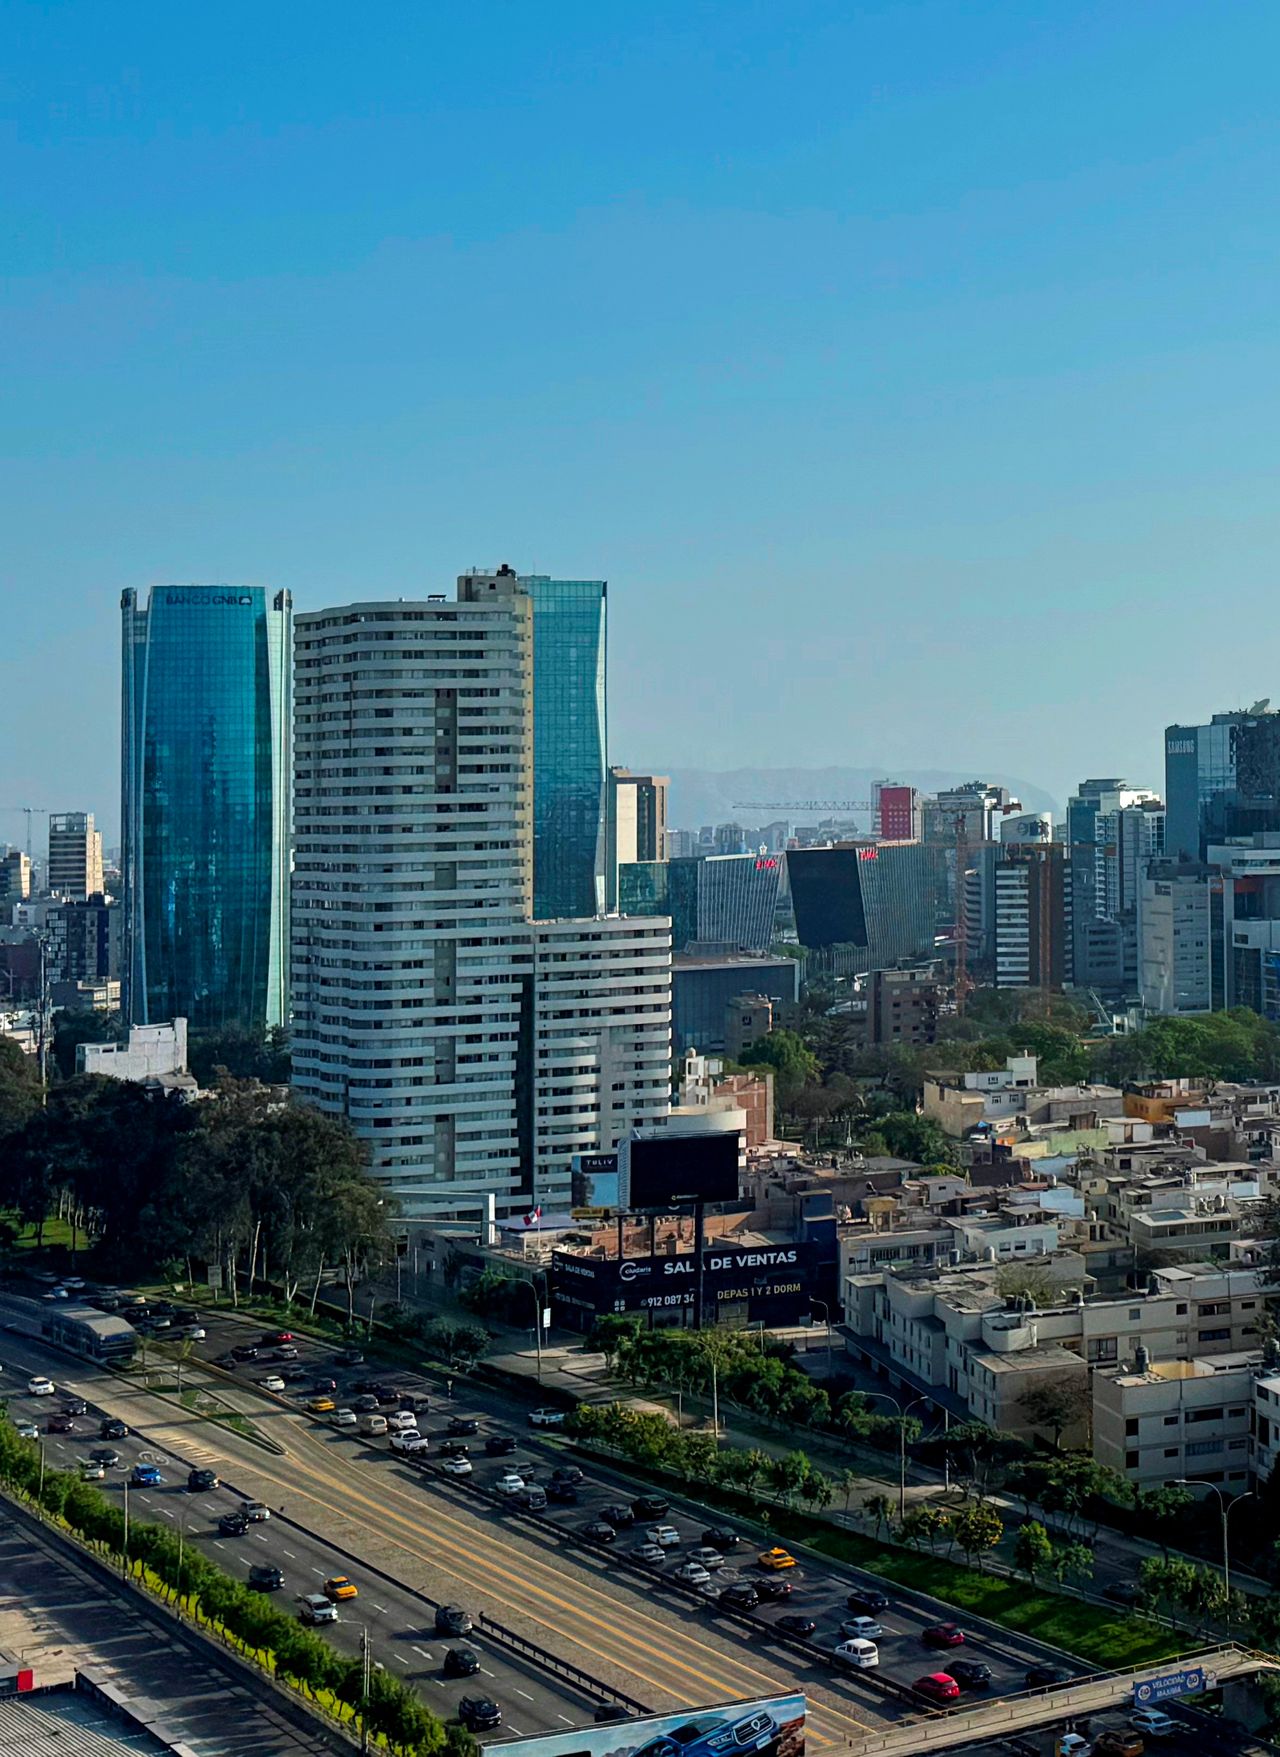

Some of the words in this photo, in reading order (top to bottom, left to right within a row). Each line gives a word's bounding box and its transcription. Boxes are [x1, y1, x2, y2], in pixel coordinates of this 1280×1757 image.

[710, 1257, 732, 1270] DE
[736, 1251, 797, 1267] VENTAS
[717, 1288, 748, 1299] DEPAS
[757, 1287, 763, 1295] Y
[766, 1286, 771, 1294] 2
[774, 1283, 801, 1294] DORM
[648, 1297, 662, 1307] 912
[664, 1295, 682, 1305] 087
